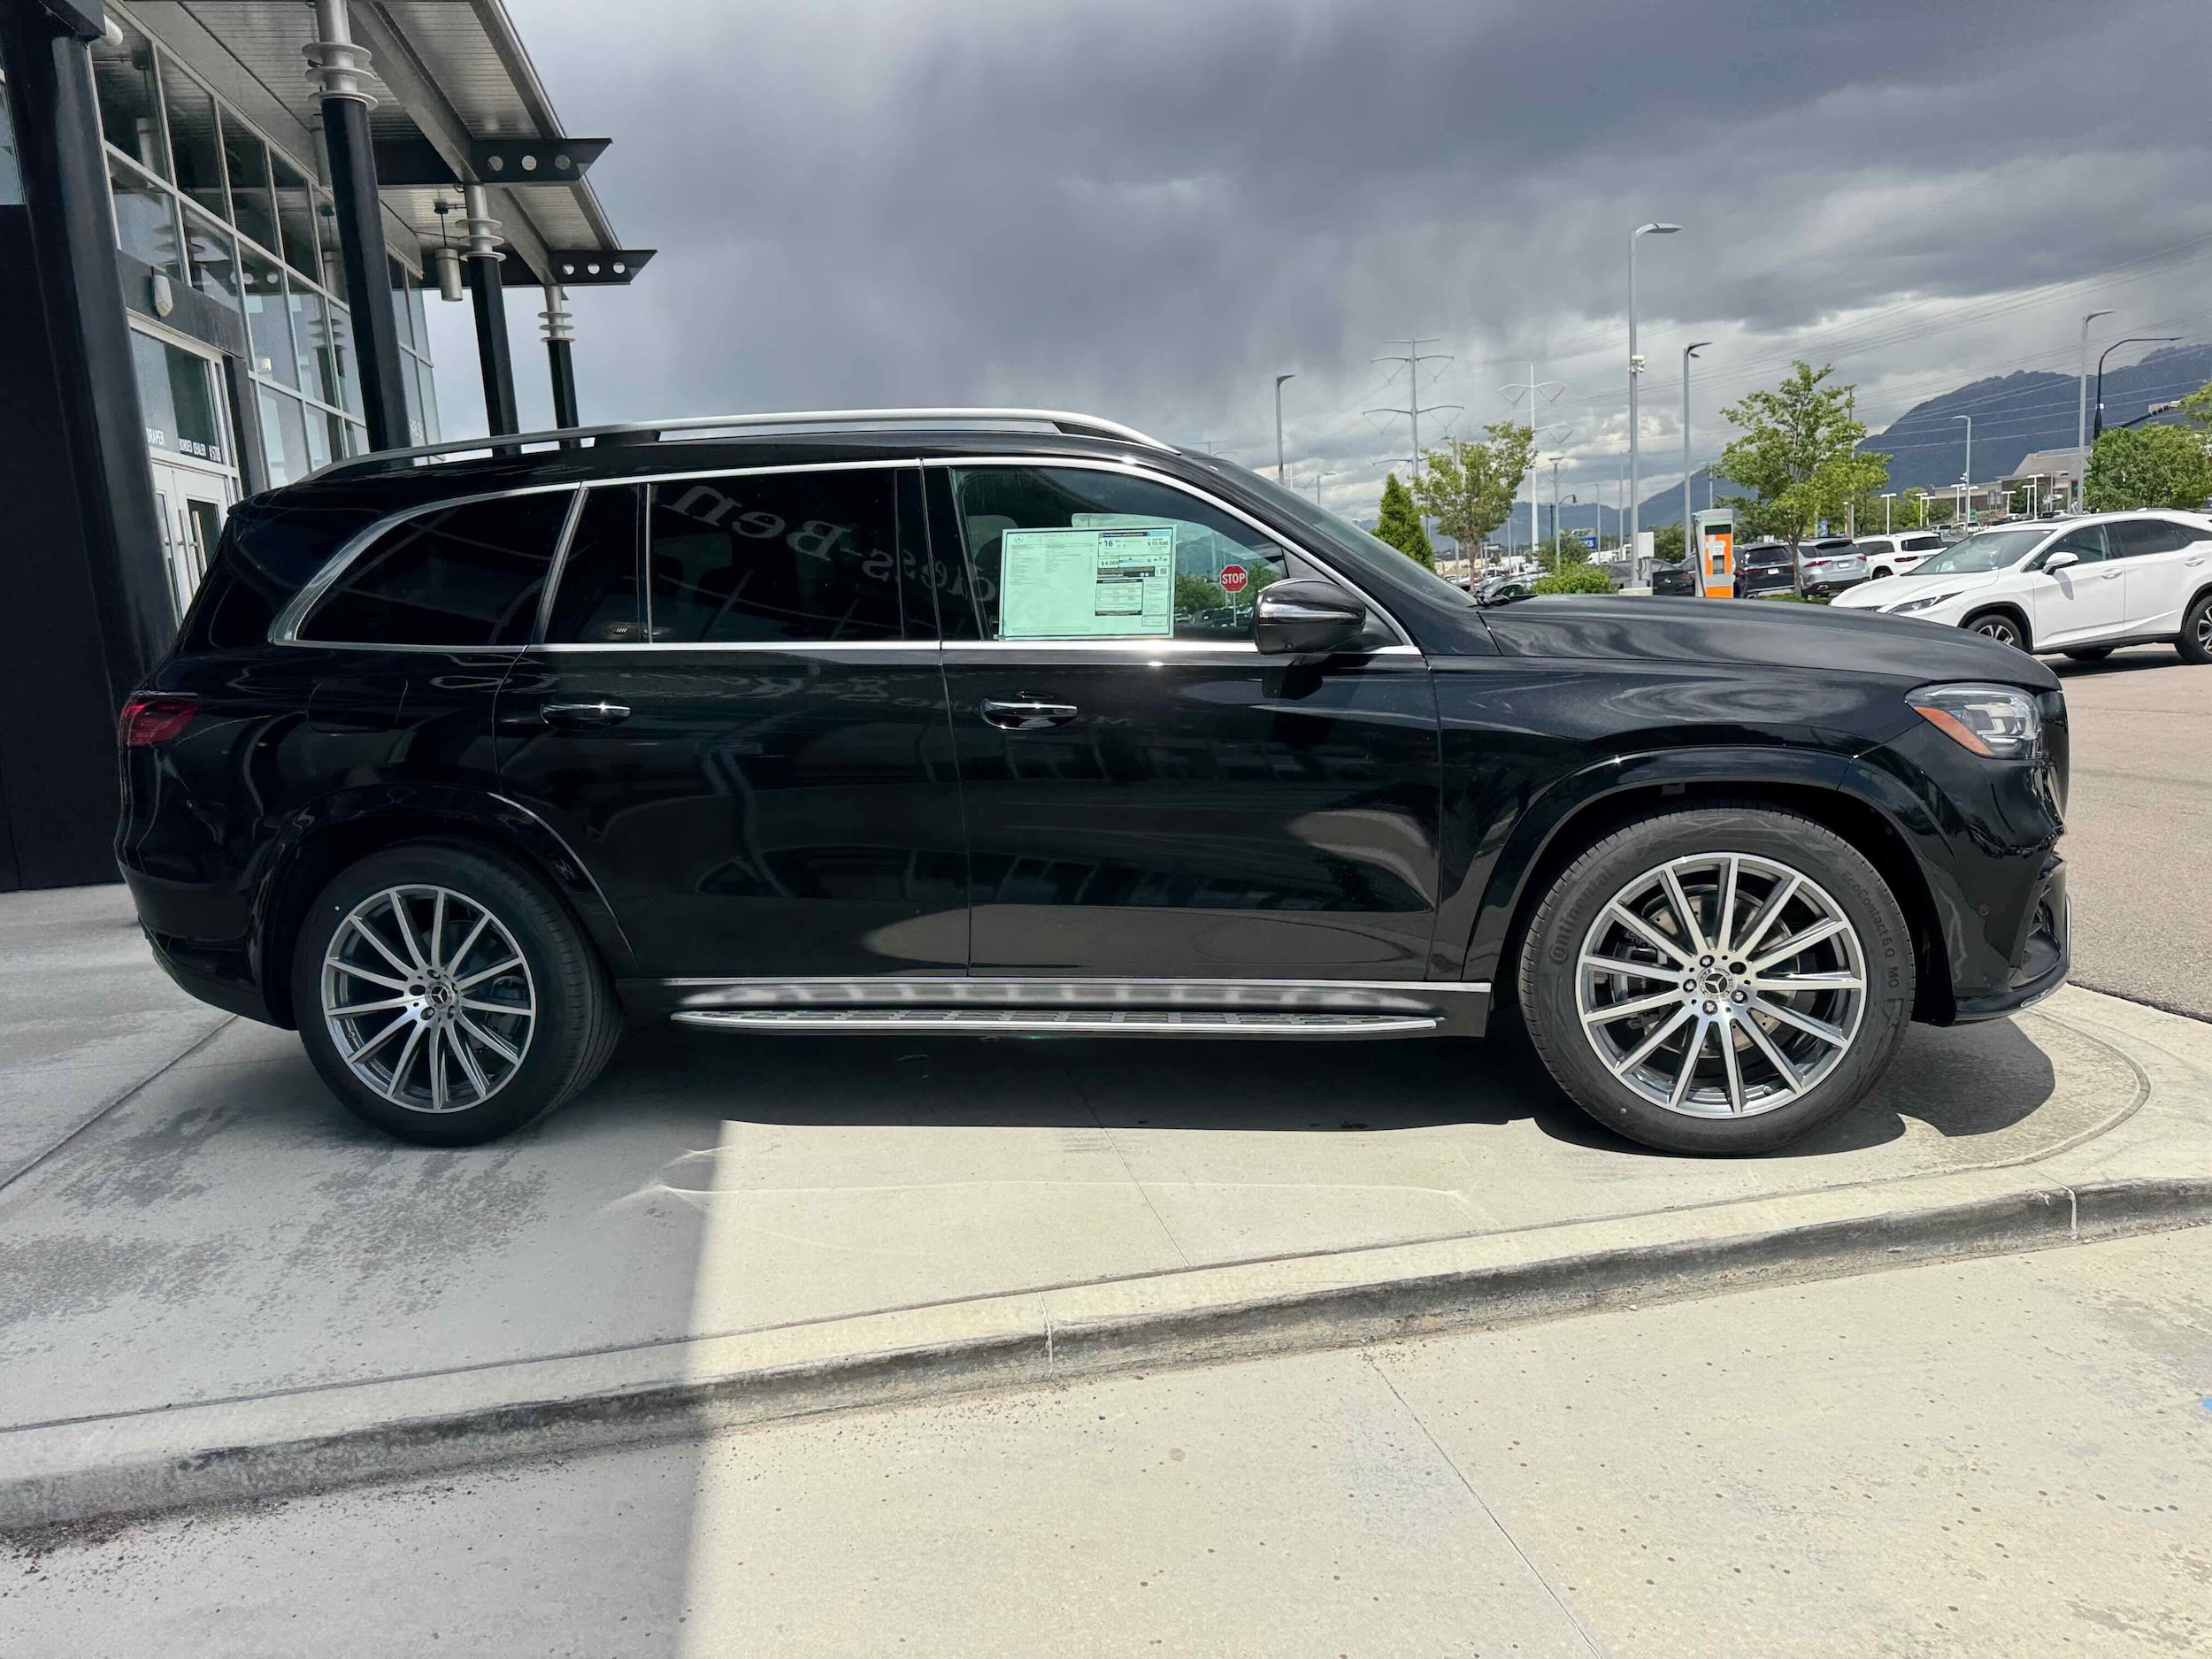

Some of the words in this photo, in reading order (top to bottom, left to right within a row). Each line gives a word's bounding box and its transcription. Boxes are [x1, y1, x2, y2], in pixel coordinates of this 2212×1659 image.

[1222, 572, 1246, 584] STOP
[1842, 870, 1889, 937] EcoContact
[1548, 867, 1612, 965] Continental
[1885, 948, 1895, 960] Q
[1888, 966, 1899, 988] MO
